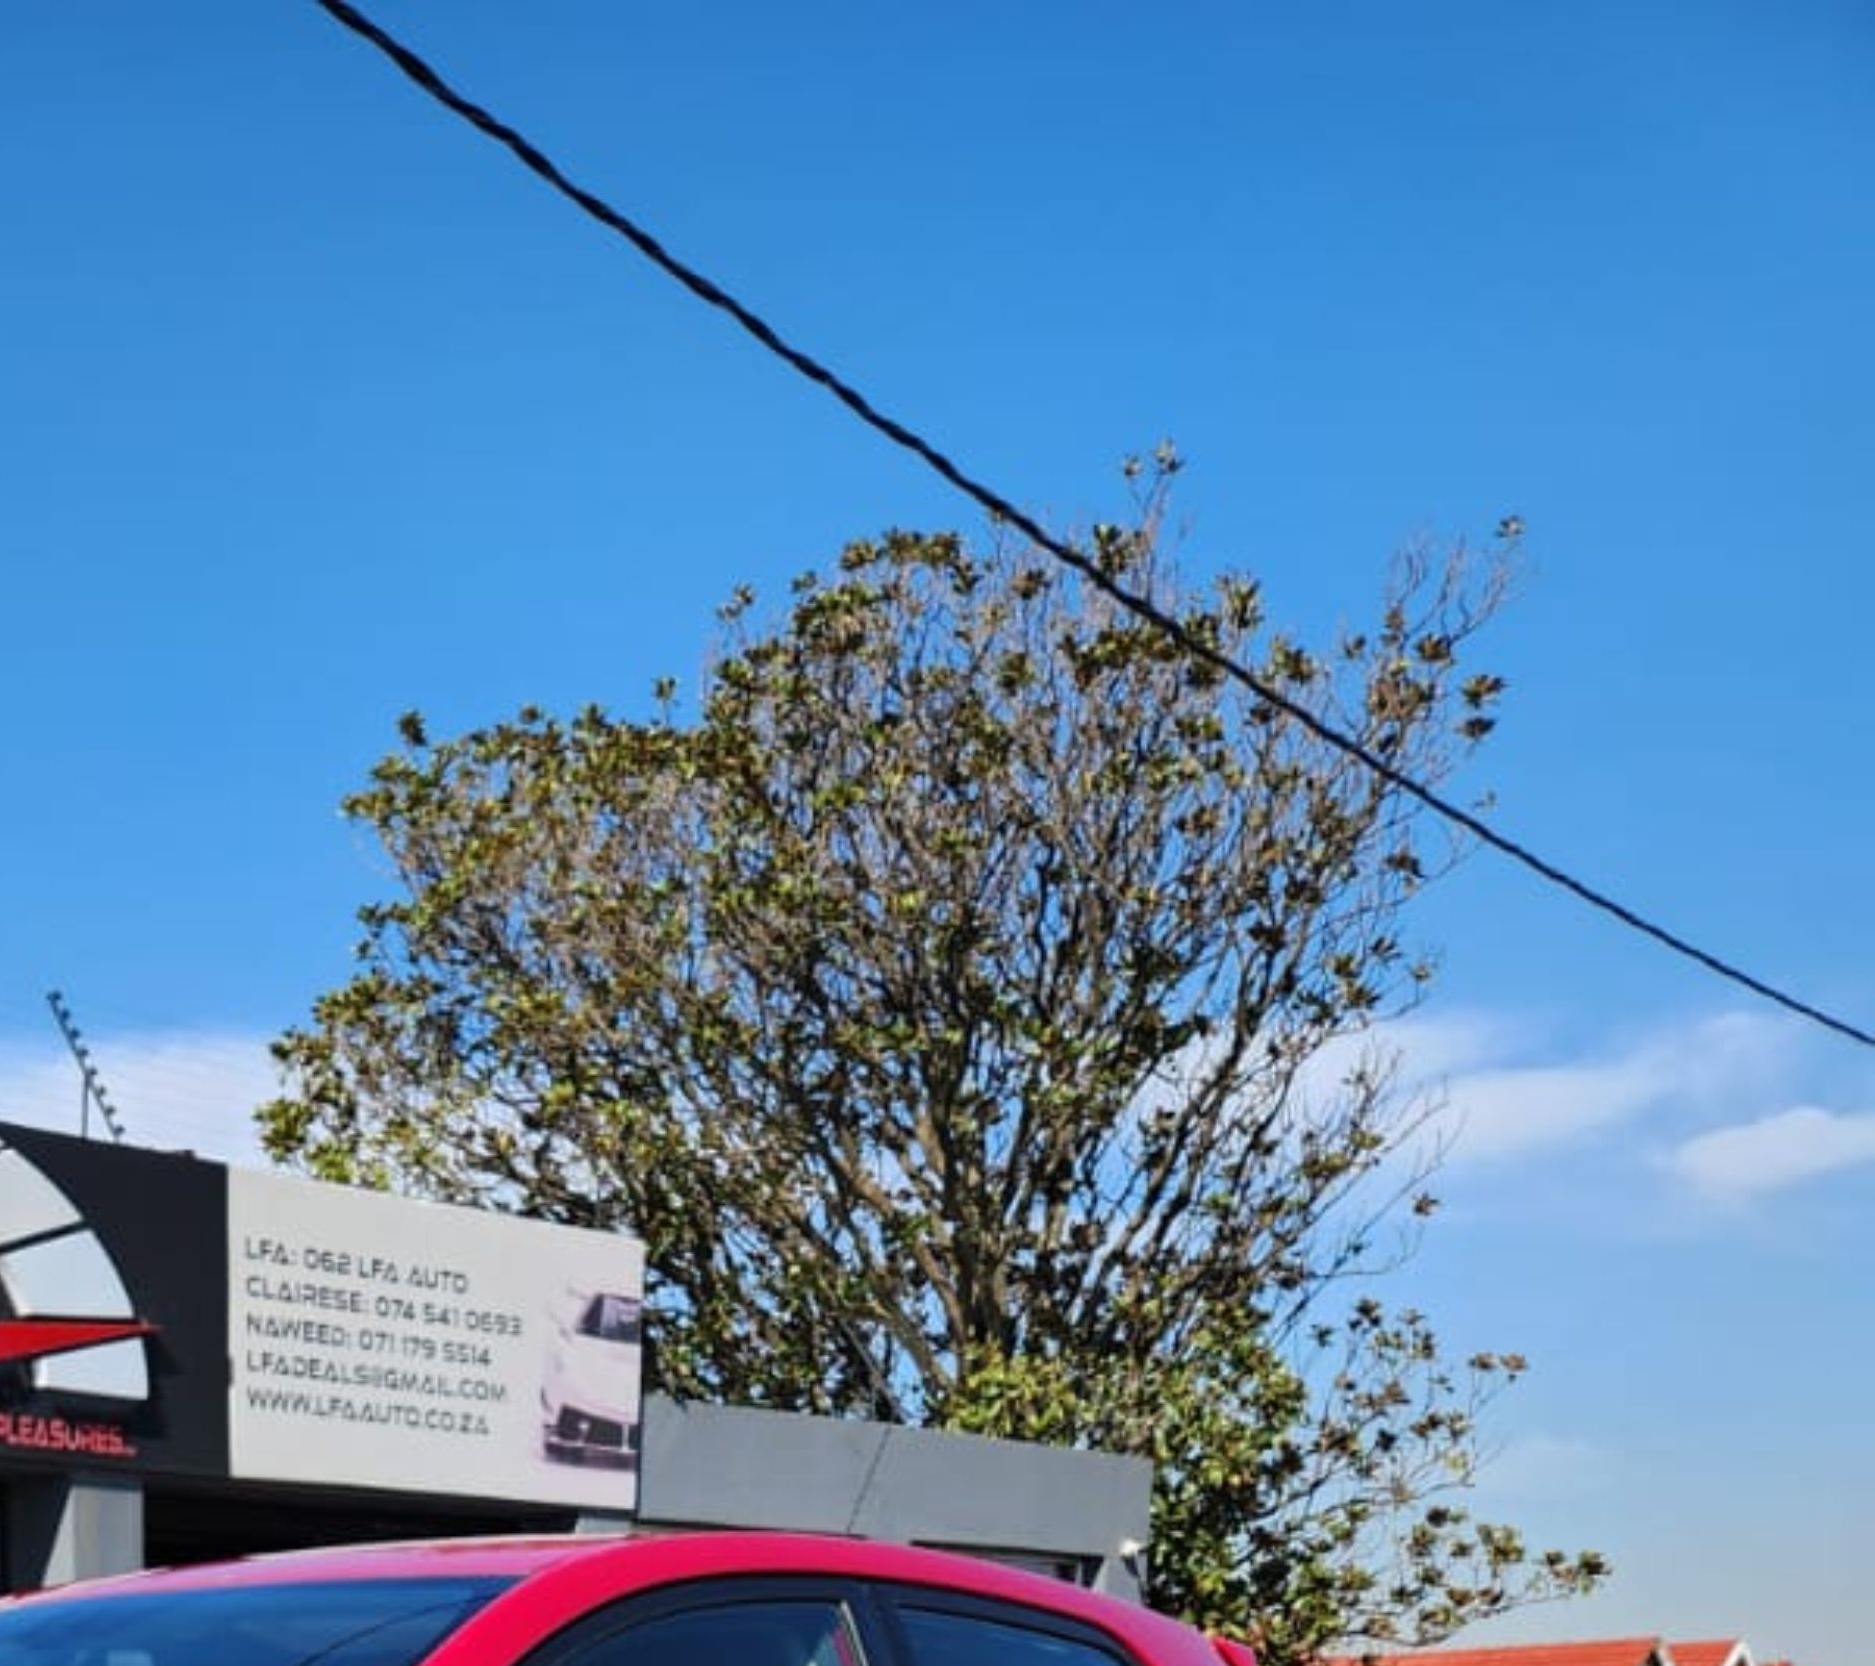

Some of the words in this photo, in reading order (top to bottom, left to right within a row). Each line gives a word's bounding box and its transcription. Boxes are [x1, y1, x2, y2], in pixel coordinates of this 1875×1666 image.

[245, 1235, 298, 1266] LFA:
[303, 1246, 352, 1276] 062
[358, 1256, 400, 1285] LFA
[408, 1264, 470, 1296] AUTO
[374, 1295, 417, 1321] 074
